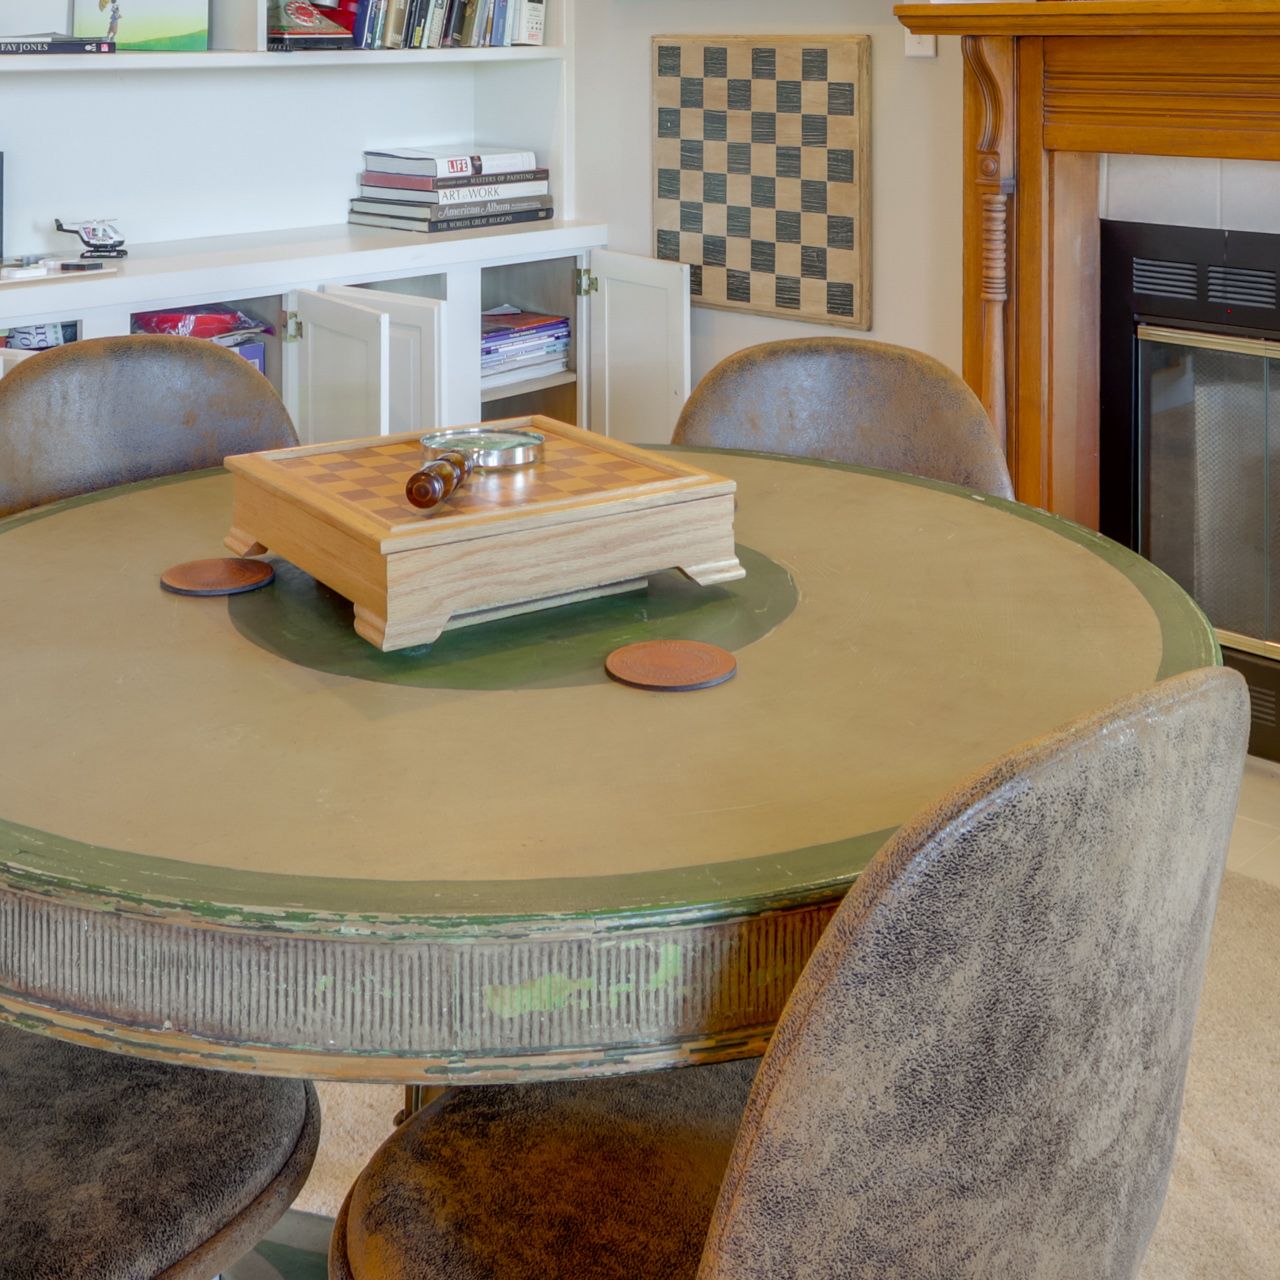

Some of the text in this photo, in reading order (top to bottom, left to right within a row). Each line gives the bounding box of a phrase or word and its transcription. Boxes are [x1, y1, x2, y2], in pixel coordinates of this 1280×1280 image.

[0, 43, 49, 52] FAY JONES
[447, 159, 468, 174] LIFE
[470, 175, 497, 184] MASTERS
[498, 174, 505, 182] OF
[506, 172, 534, 182] PAINTING
[441, 186, 501, 201] ART WORK
[437, 202, 511, 219] American Album
[437, 222, 447, 230] THE
[471, 218, 488, 227] GREAT
